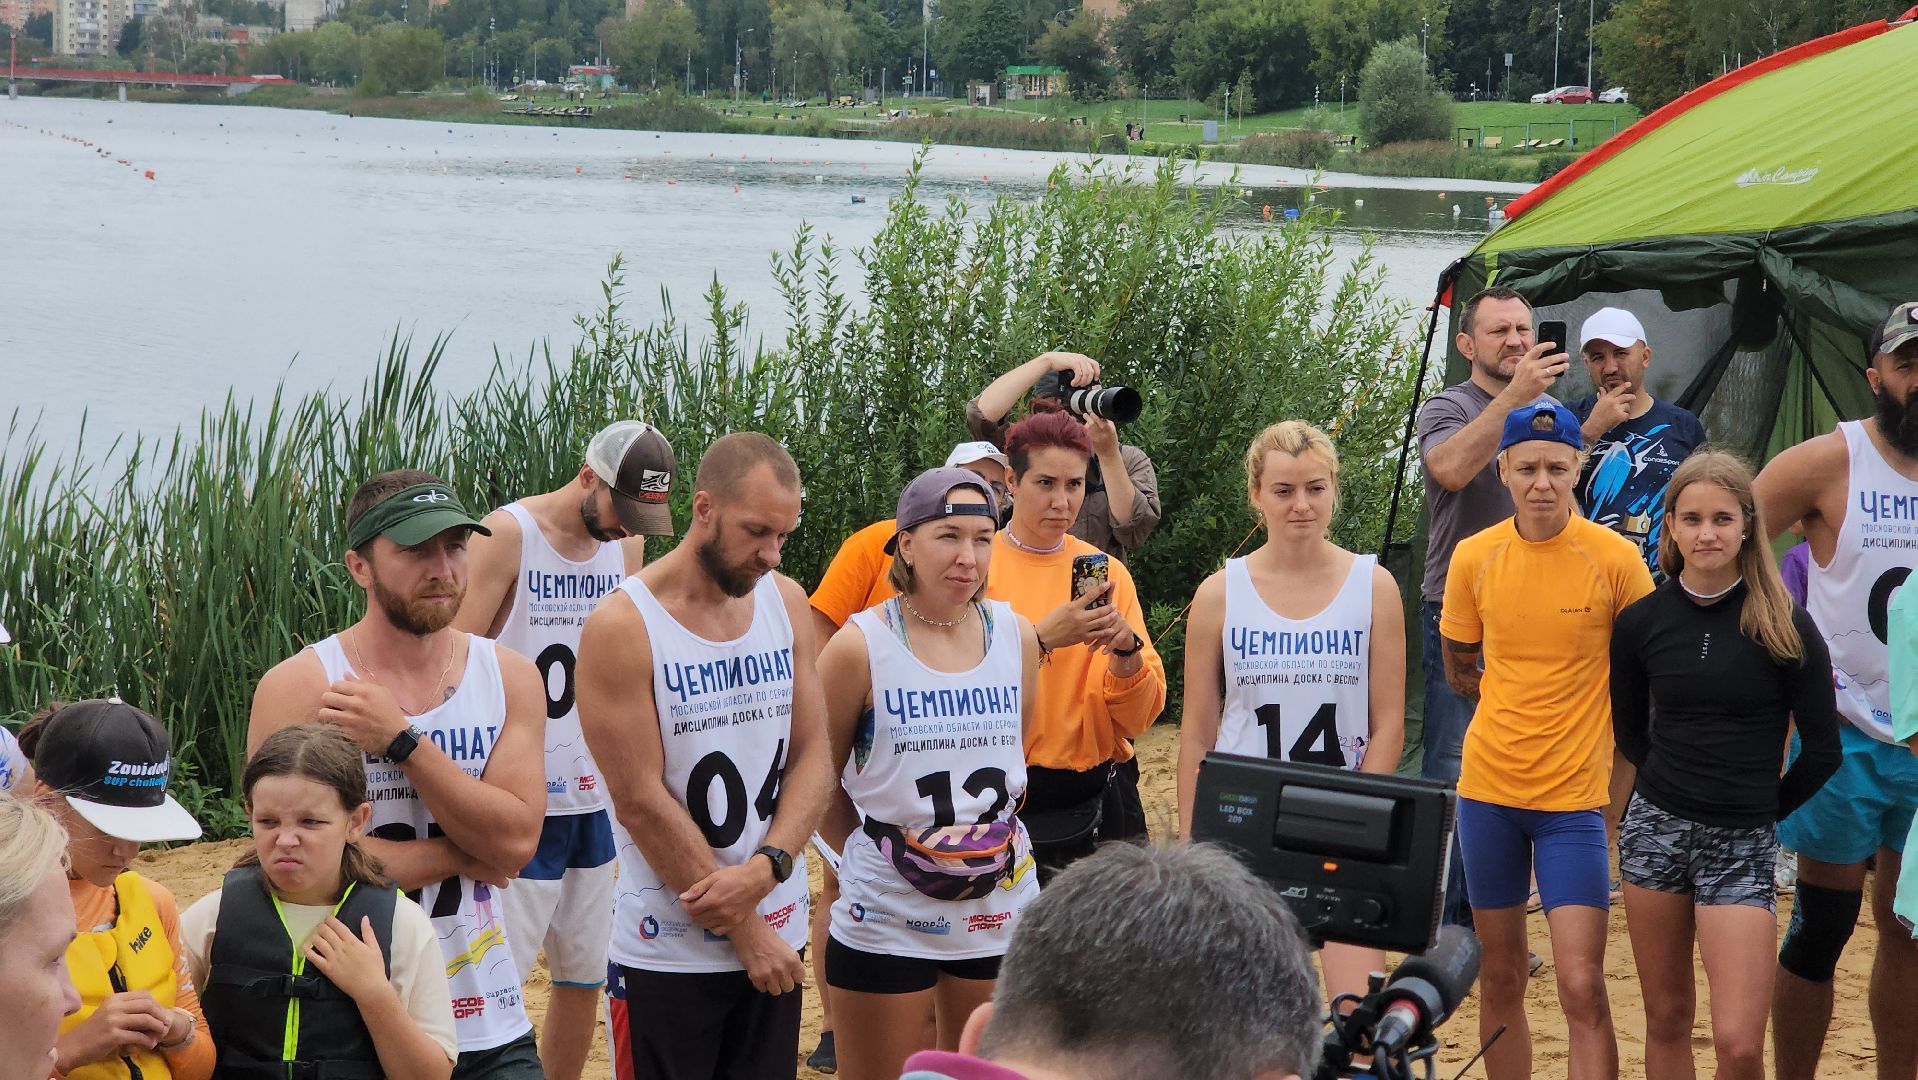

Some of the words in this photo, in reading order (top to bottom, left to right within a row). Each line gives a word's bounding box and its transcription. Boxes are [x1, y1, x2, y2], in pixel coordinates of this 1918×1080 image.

[1231, 627, 1364, 660] ЧЕМПИОНАТ
[1318, 660, 1328, 669] ПО
[663, 647, 793, 702] ЧЕМПИОНАТ
[1236, 674, 1289, 687] ДИСЦИПЛИНА
[1293, 674, 1323, 686] ДОСКА
[1326, 673, 1332, 683] С
[1334, 674, 1359, 685] ВЕСЛОМ
[756, 690, 767, 702] ПО
[885, 686, 1018, 724] ЧЕМПИОНАТ
[674, 715, 729, 736] ДИСЦИПЛИНА
[732, 709, 765, 726] ДОСКА
[768, 706, 773, 719] С
[890, 722, 944, 739] МОСКОВСКОЙ
[946, 721, 980, 733] ОБЛАСТИ
[983, 720, 993, 730] ПО
[1254, 703, 1347, 767] 14
[894, 739, 956, 755] ДИСЦИПЛИНА
[960, 738, 988, 750] ДОСКА
[992, 735, 997, 743] С
[915, 767, 1011, 828] 12
[770, 914, 791, 931] ПОРТ
[967, 922, 1004, 932] СПОРТ
[968, 911, 1012, 924] МОСОБЛ
[453, 1008, 485, 1019] ОРТ
